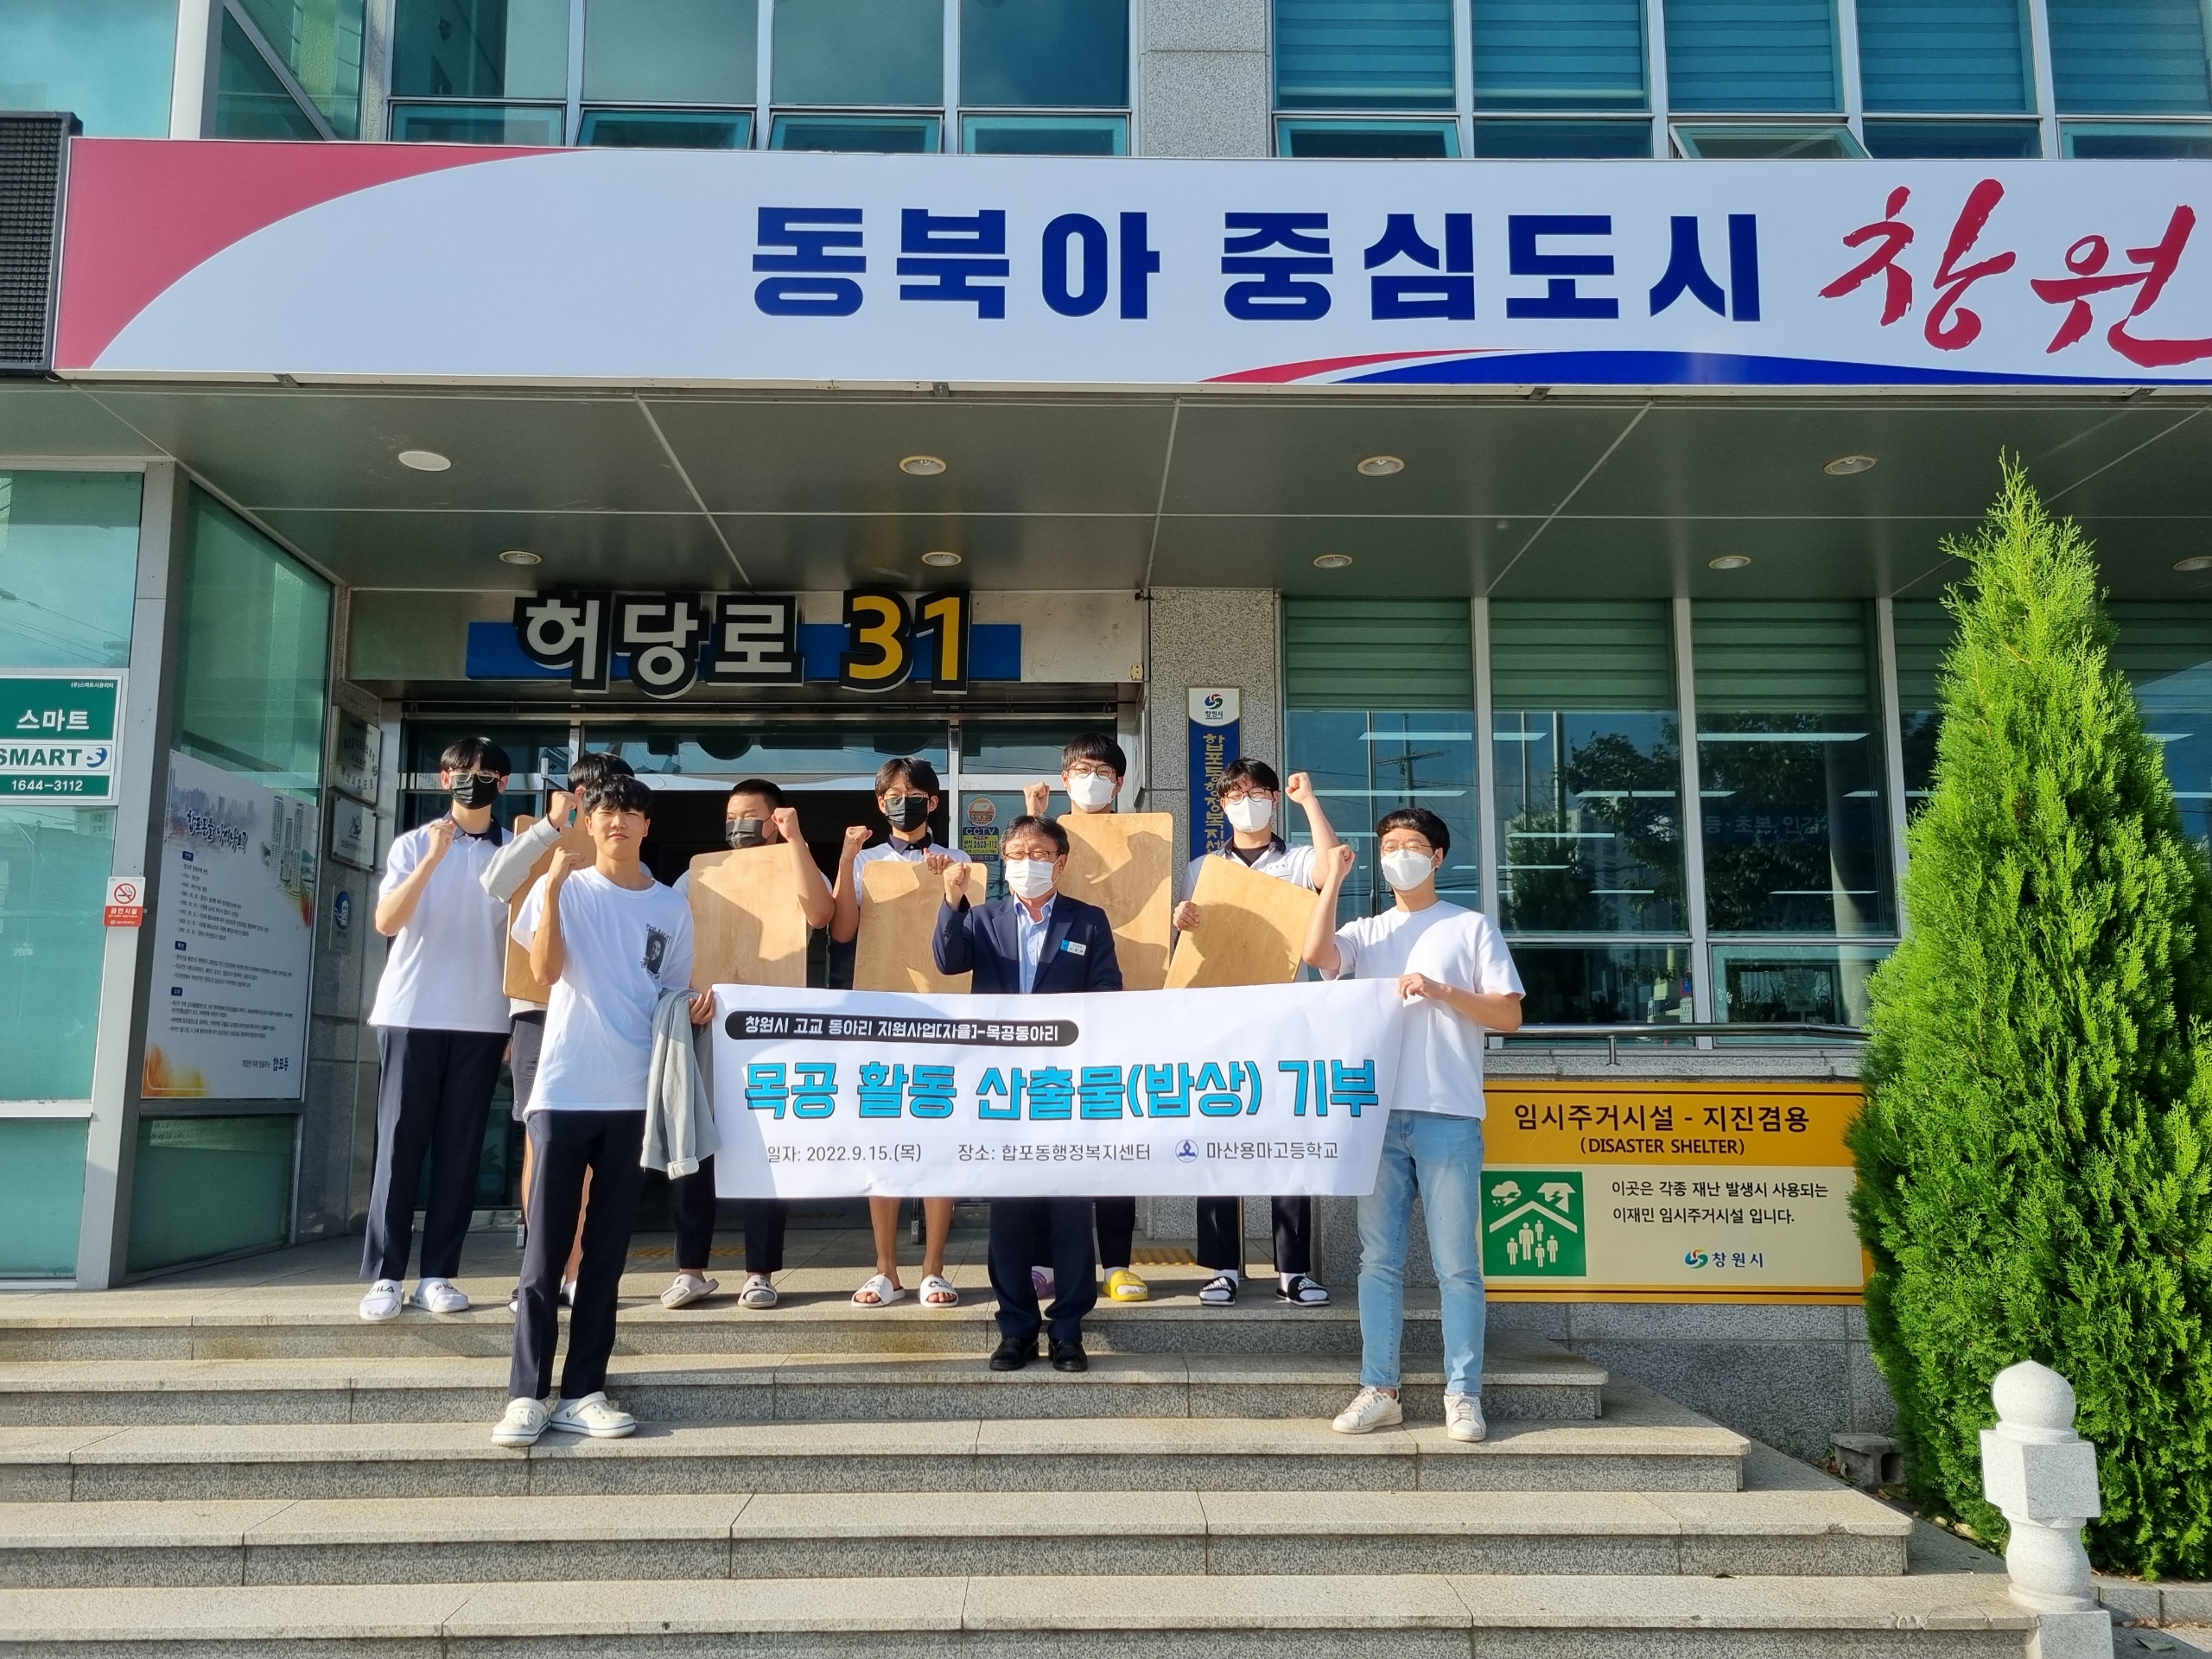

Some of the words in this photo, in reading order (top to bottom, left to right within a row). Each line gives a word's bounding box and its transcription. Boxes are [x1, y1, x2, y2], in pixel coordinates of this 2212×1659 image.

[751, 206, 1160, 319] 동북아
[1221, 211, 1760, 322] 중심도시
[1817, 178, 2212, 368] 창원
[520, 594, 797, 692] 허당로
[845, 591, 965, 688] 31
[16, 709, 90, 732] 스마트
[12, 779, 83, 791] 1644-3112
[965, 827, 995, 836] CCTV
[745, 1015, 789, 1034] 창원시
[793, 1018, 823, 1034] 고교
[829, 1020, 872, 1037] 동아리
[745, 1062, 839, 1120] 목공
[857, 1060, 957, 1119] 활동
[976, 1059, 1263, 1122] 산출물(밥상)
[1278, 1058, 1379, 1117] 기부
[1514, 1103, 1675, 1132] 임시주거시설
[1703, 1105, 1809, 1133] 지진겸용
[767, 1145, 802, 1164] 일자:
[806, 1144, 922, 1165] 2022.9.15.(목)
[957, 1143, 996, 1162] 장소:
[1001, 1142, 1151, 1163] 합포동행정복지센터
[1206, 1141, 1338, 1160] 마산용마고등학교
[1580, 1137, 1663, 1154] (DISASTER
[1670, 1138, 1745, 1156] SHELTER)
[1611, 1180, 1654, 1197] 이곳은
[1658, 1181, 1687, 1198] 각종
[1692, 1181, 1720, 1198] 재난
[1726, 1181, 1767, 1198] 발생시
[1772, 1182, 1828, 1198] 사용되는
[1612, 1207, 1655, 1224] 이재민
[1659, 1208, 1744, 1224] 임시주거시설
[1750, 1208, 1795, 1224] 입니다.
[1712, 1251, 1764, 1268] 창원시
[369, 1285, 395, 1295] FILA
[434, 1283, 459, 1292] FIL
